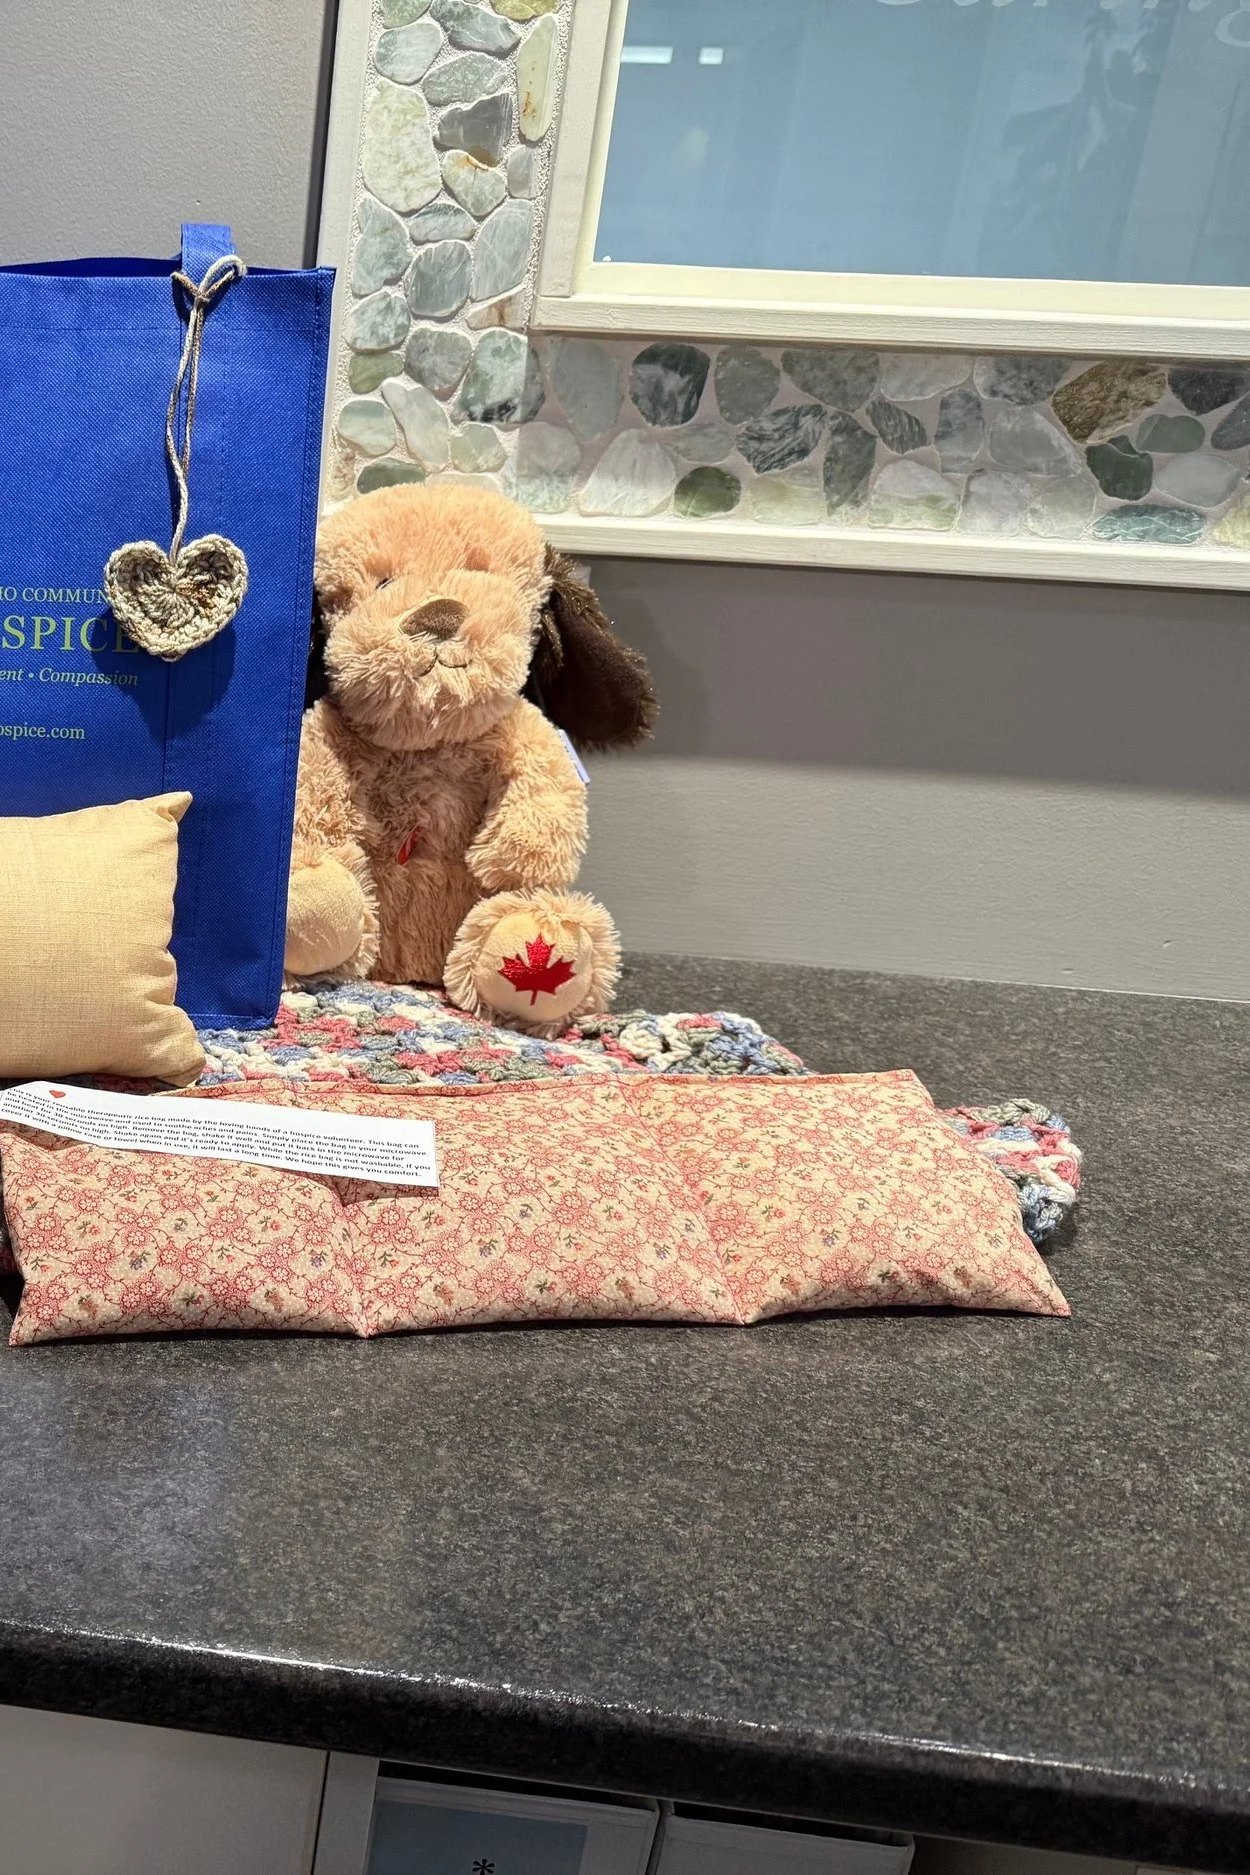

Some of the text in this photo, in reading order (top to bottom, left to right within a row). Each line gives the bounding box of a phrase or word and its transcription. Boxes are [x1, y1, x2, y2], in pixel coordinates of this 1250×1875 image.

[39, 667, 139, 687] Compassion
[132, 1126, 165, 1134] Remove
[343, 1152, 390, 1161] microwave
[219, 1122, 244, 1130] loving
[290, 1131, 321, 1140] hospice
[323, 1136, 365, 1145] volunteer.
[262, 1133, 289, 1143] Simply
[92, 1127, 111, 1135] high.
[259, 1146, 283, 1154] While
[361, 1161, 404, 1170] washable,
[261, 1152, 283, 1160] time.
